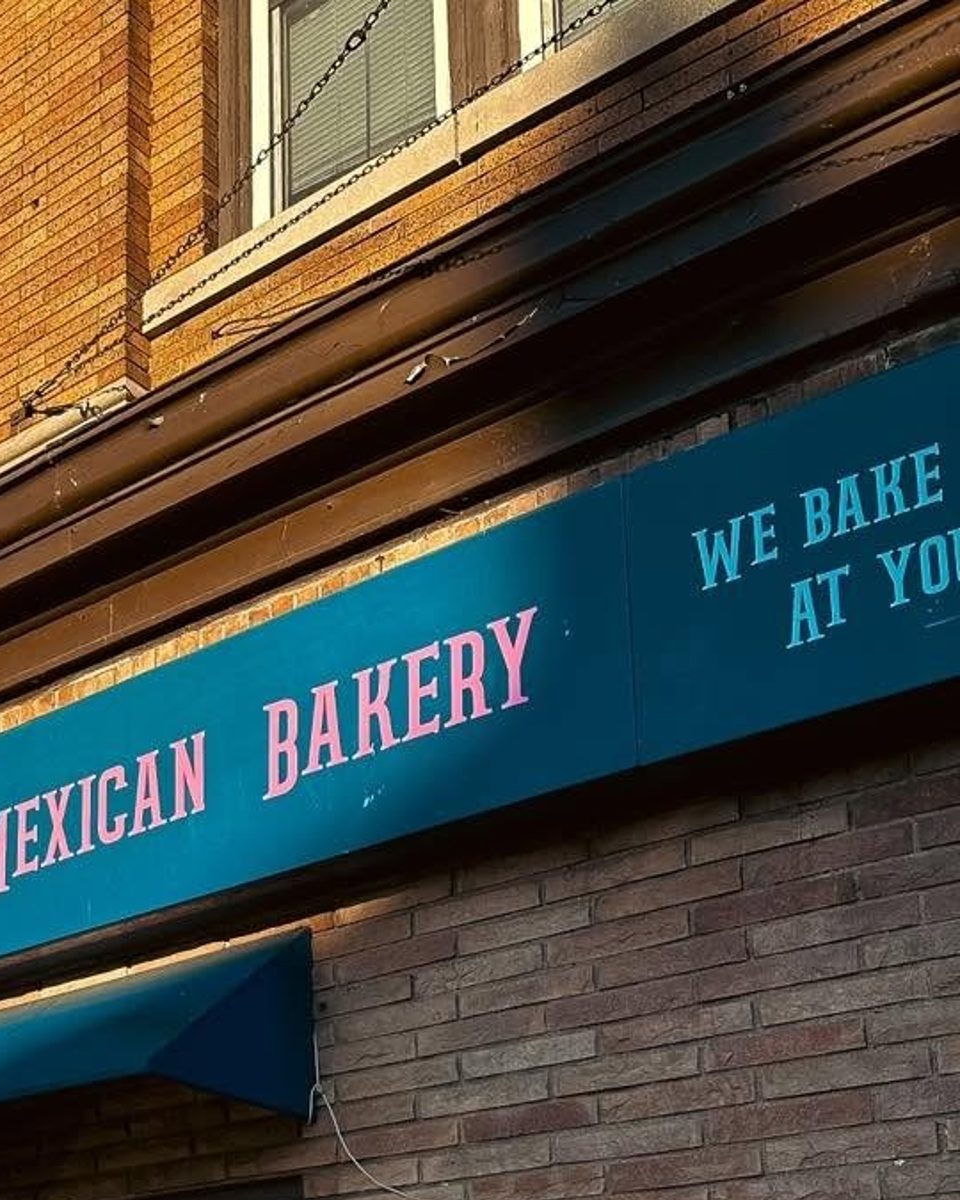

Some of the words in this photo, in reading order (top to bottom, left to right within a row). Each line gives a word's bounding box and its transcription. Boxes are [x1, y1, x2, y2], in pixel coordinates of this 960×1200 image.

[692, 503, 778, 591] WE
[799, 442, 944, 548] BAKE
[786, 564, 850, 649] AT
[262, 605, 538, 801] BAKERY
